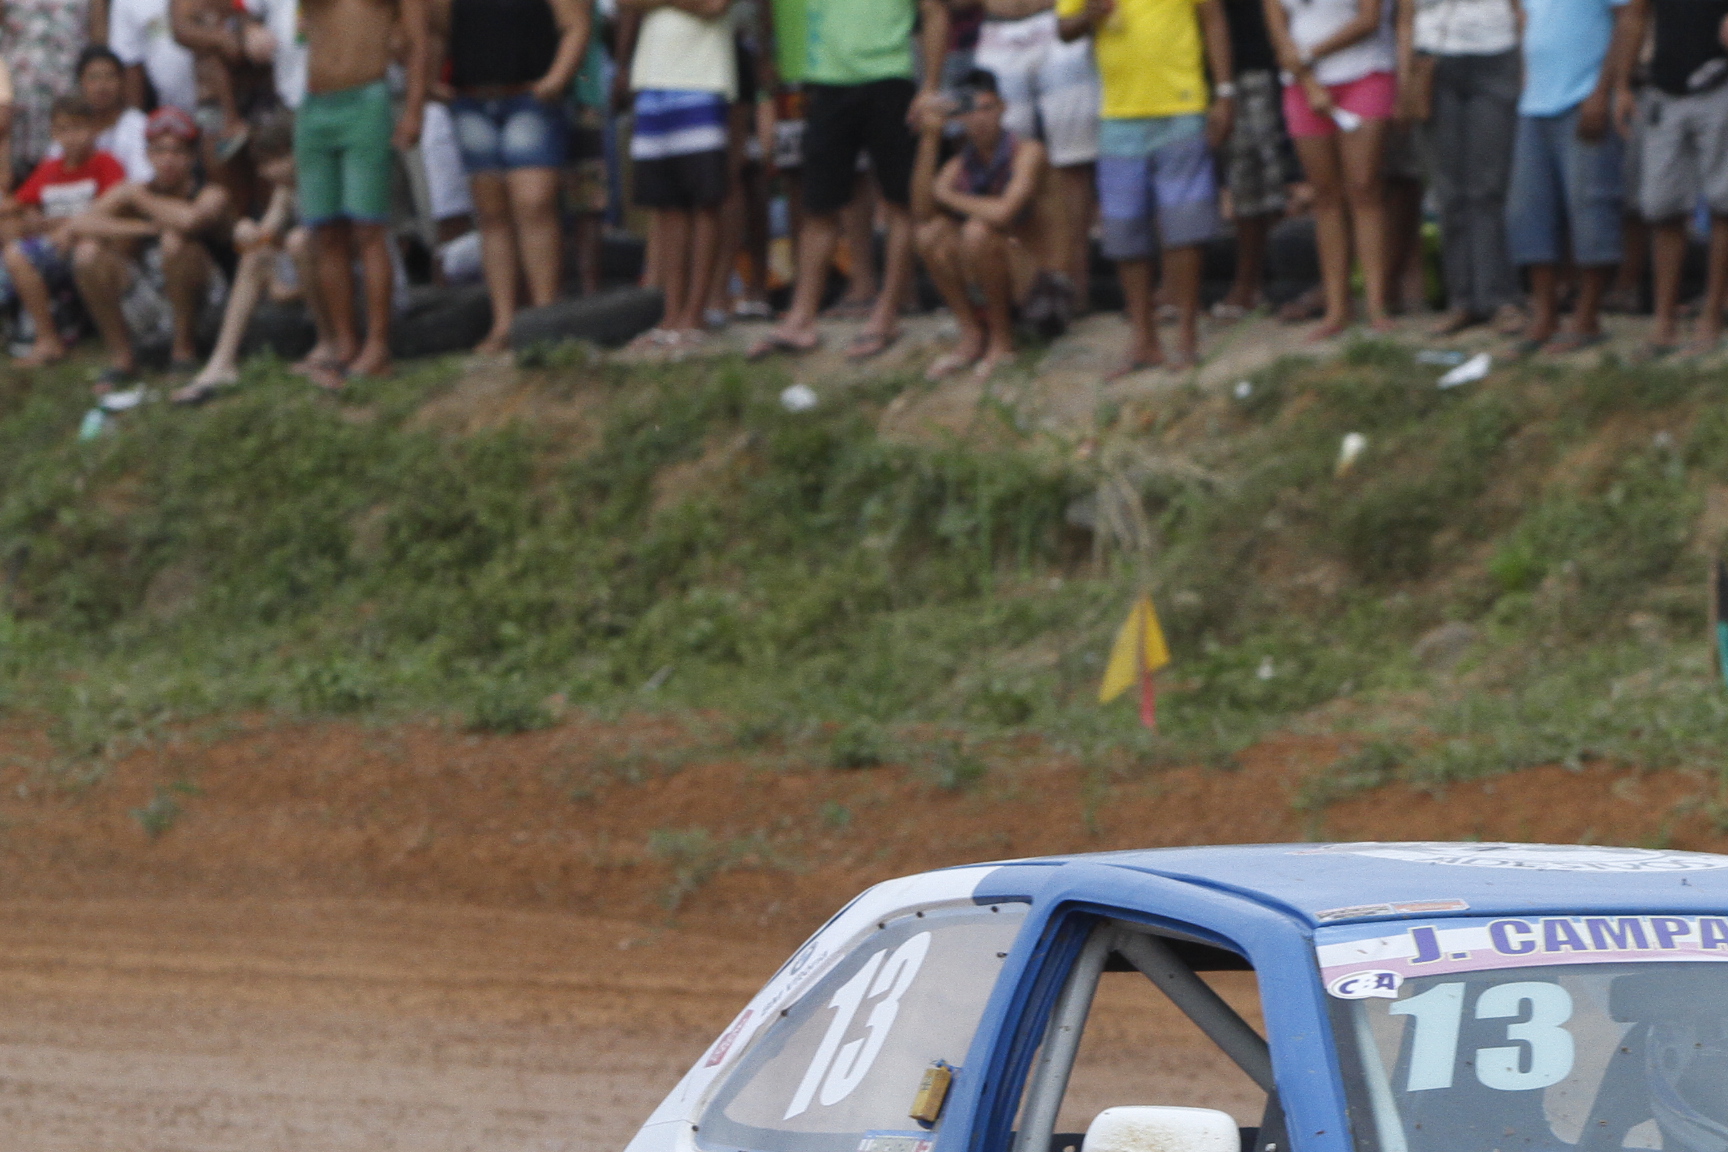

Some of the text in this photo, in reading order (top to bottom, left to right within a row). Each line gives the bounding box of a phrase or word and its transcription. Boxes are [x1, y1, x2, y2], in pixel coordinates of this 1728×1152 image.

[1409, 925, 1472, 966] J.
[783, 931, 931, 1120] 13
[1389, 981, 1576, 1092] 13
